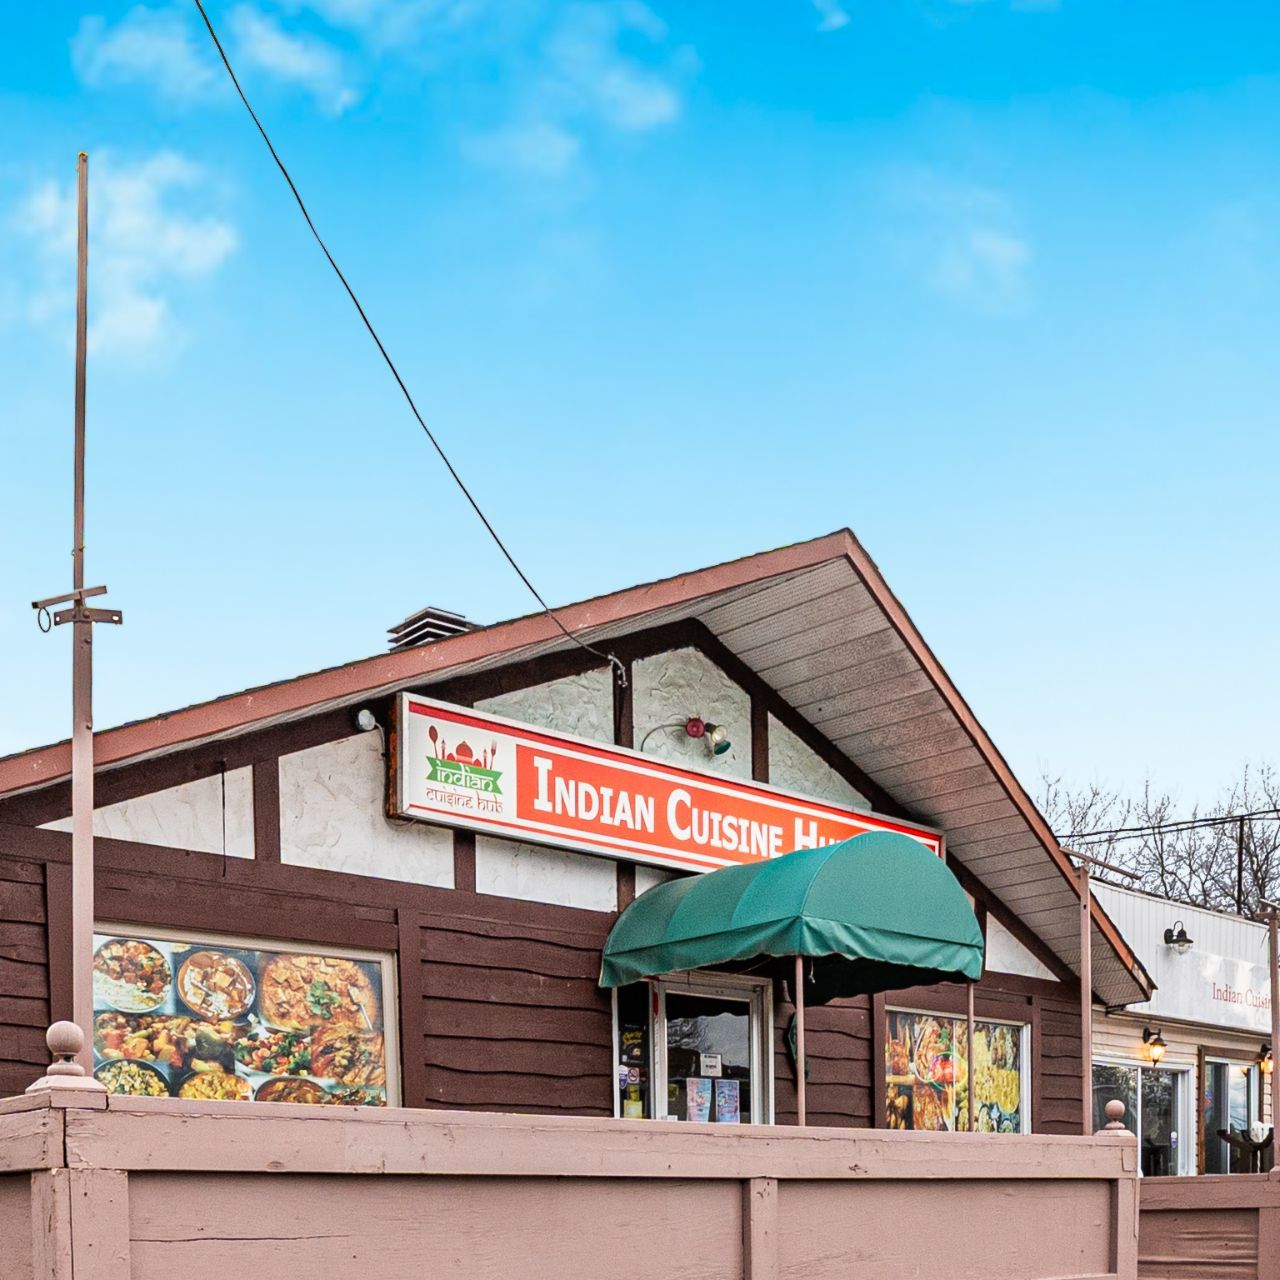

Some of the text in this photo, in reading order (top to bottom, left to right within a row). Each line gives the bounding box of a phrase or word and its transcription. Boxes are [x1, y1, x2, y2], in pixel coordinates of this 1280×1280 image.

[435, 760, 494, 791] indian
[426, 785, 503, 813] cuisine hub
[533, 755, 655, 833] INDIAN
[666, 788, 783, 858] CUISINE
[1212, 982, 1243, 1004] Indian
